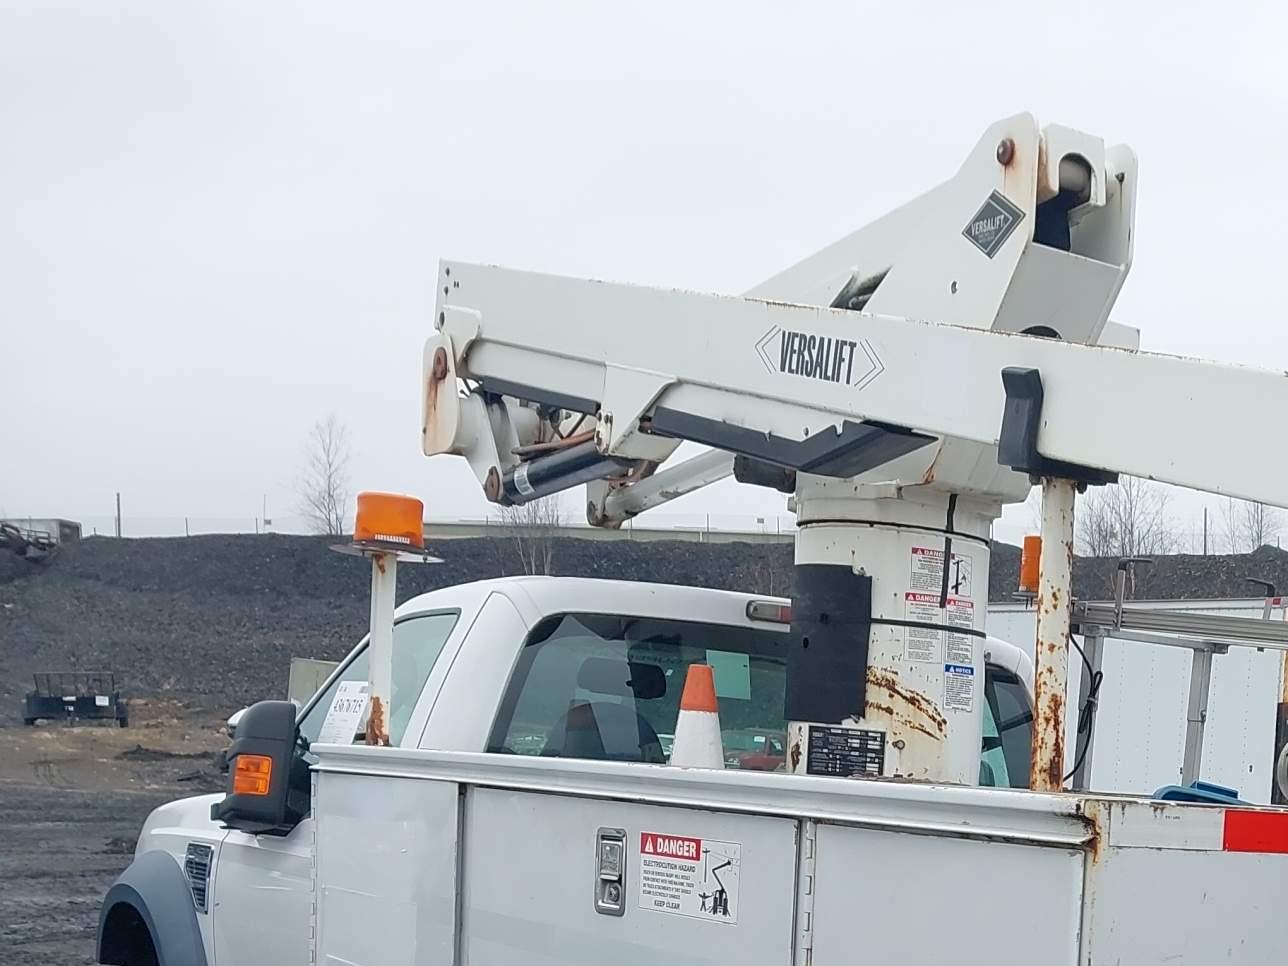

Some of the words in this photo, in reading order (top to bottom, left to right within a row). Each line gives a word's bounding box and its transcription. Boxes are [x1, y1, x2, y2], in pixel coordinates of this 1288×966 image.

[971, 214, 1005, 237] VERSALIFT
[779, 329, 858, 388] VERSALIFT
[657, 837, 697, 858] DANGER
